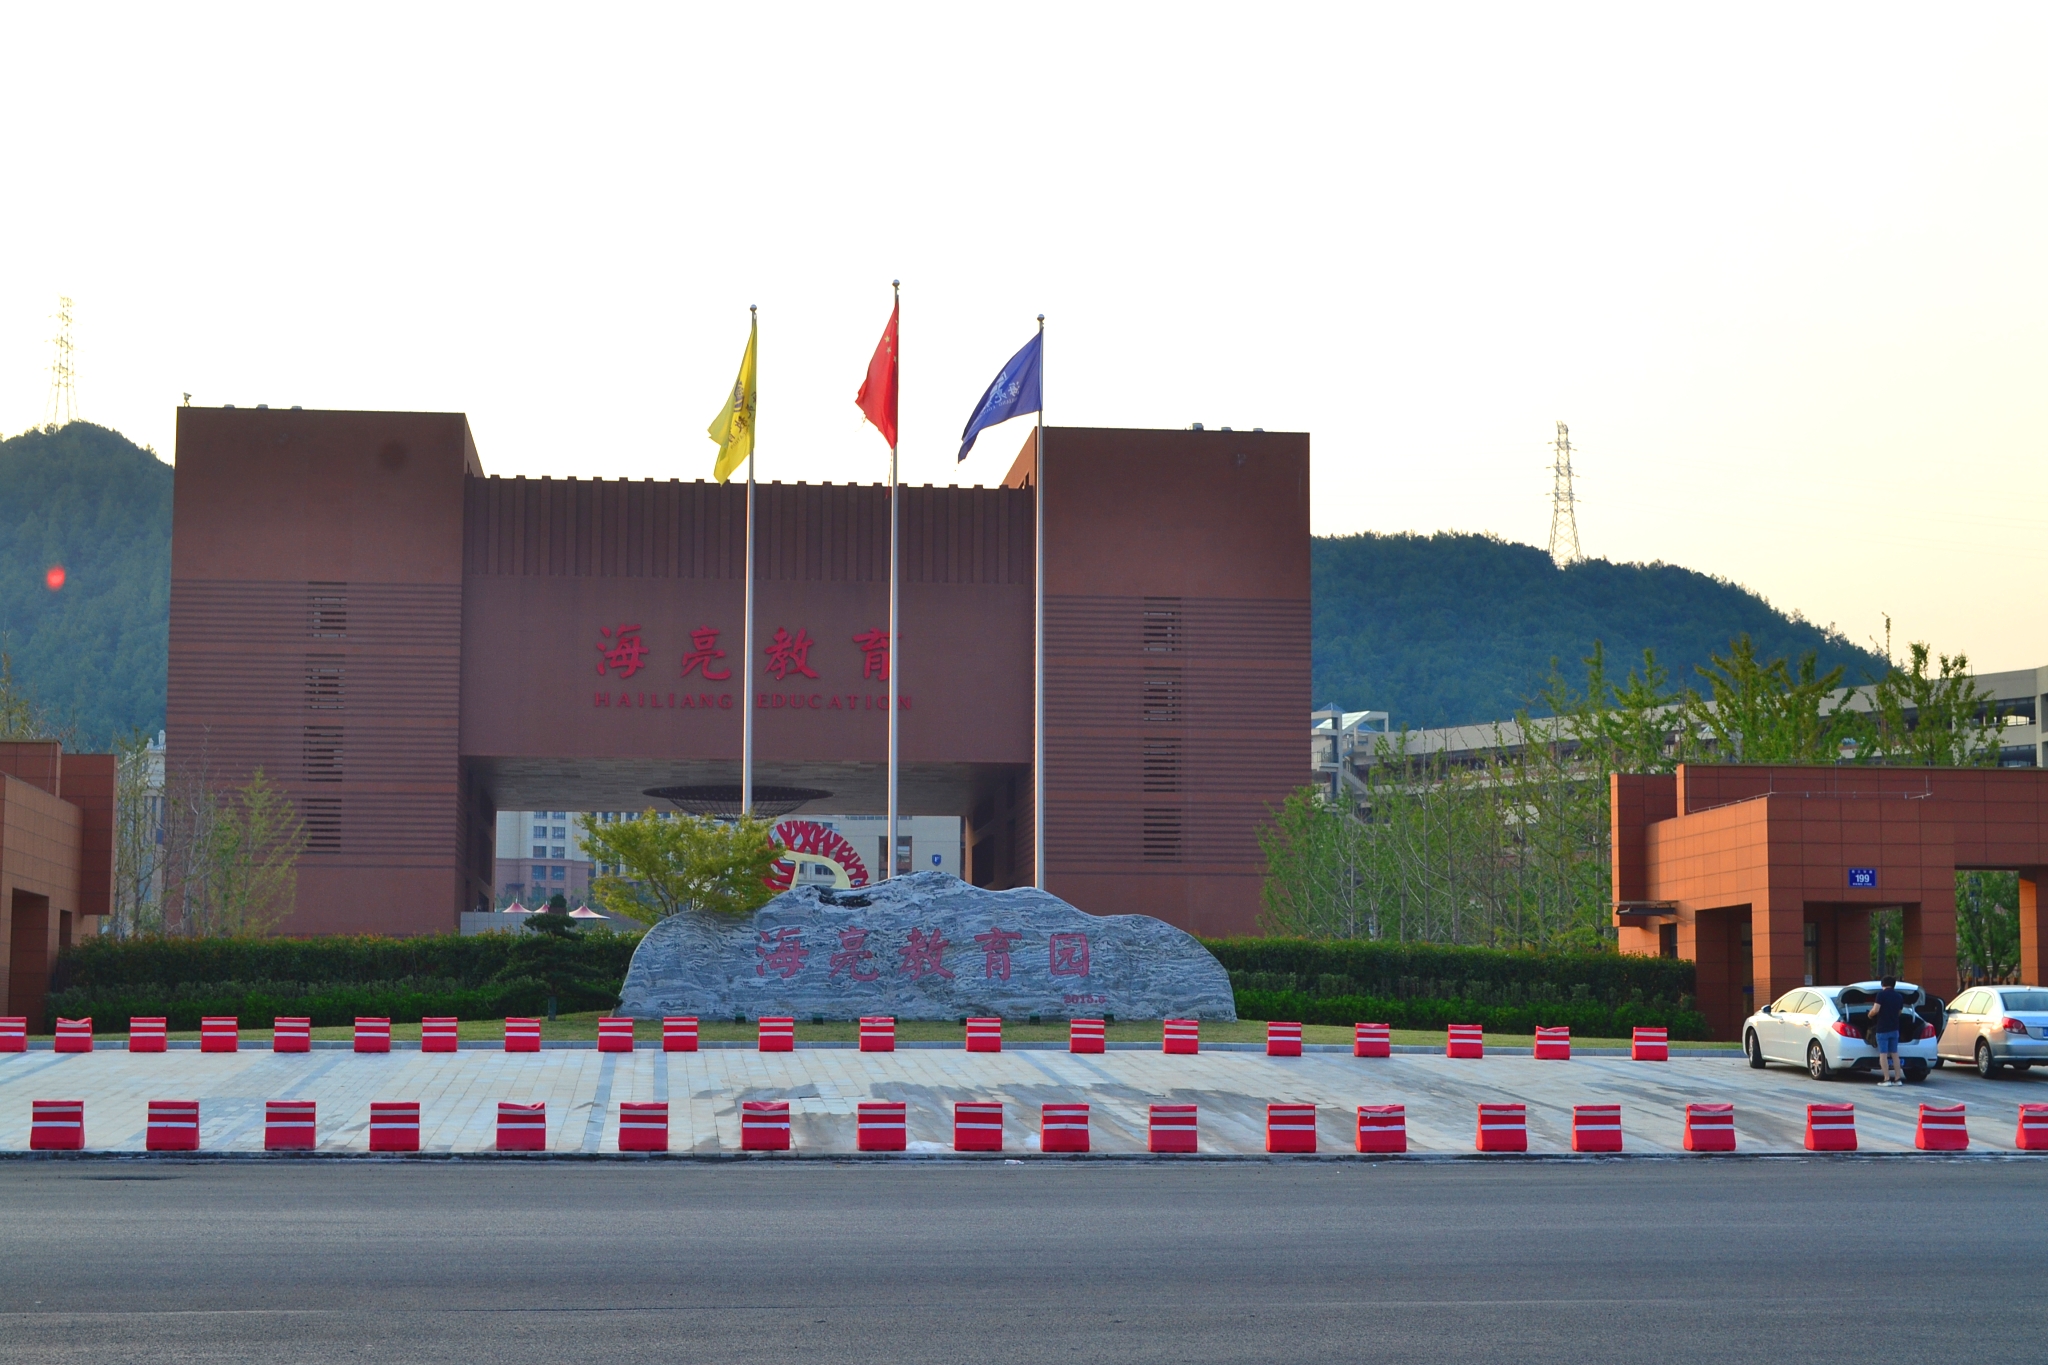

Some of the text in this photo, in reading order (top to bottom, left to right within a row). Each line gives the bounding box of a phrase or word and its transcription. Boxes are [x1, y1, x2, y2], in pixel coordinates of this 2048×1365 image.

[596, 624, 900, 681] 海亮教育
[594, 692, 912, 710] HAILIANG EDUCATION
[1855, 874, 1870, 883] 199
[756, 925, 1090, 981] 海亮教育园
